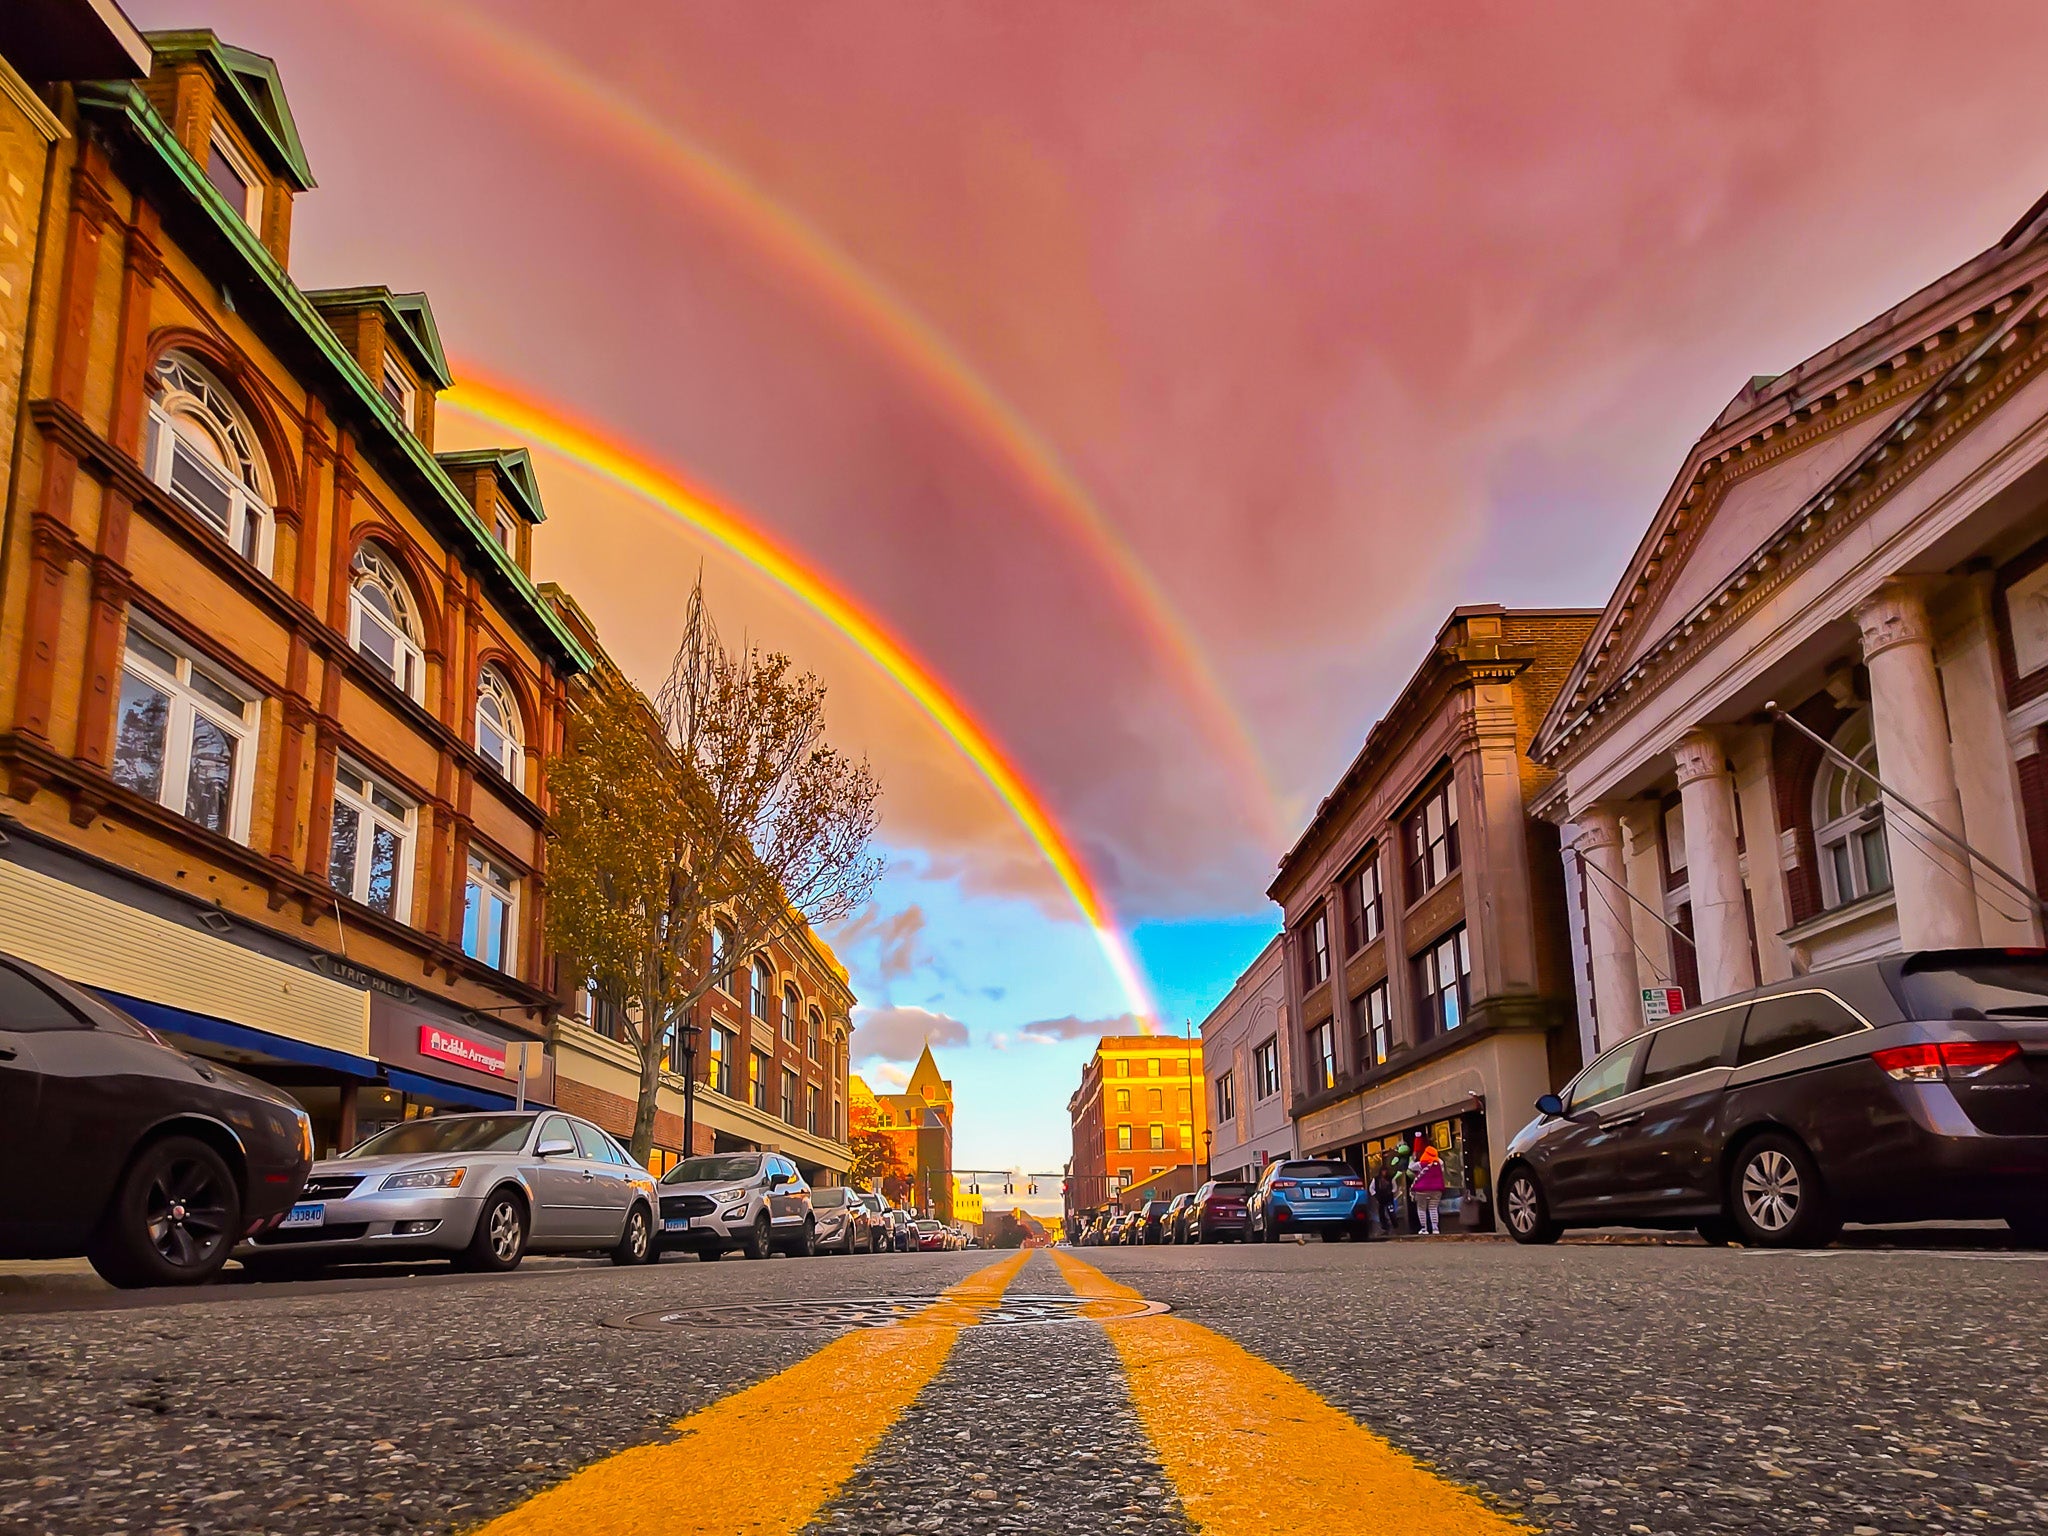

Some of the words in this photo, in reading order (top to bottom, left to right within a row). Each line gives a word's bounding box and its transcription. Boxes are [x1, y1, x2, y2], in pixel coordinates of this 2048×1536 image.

[333, 963, 367, 985] LYRIC
[372, 977, 400, 998] HALL
[1645, 991, 1651, 1000] 2
[441, 1038, 468, 1059] Edible
[468, 1048, 505, 1072] Arrangem
